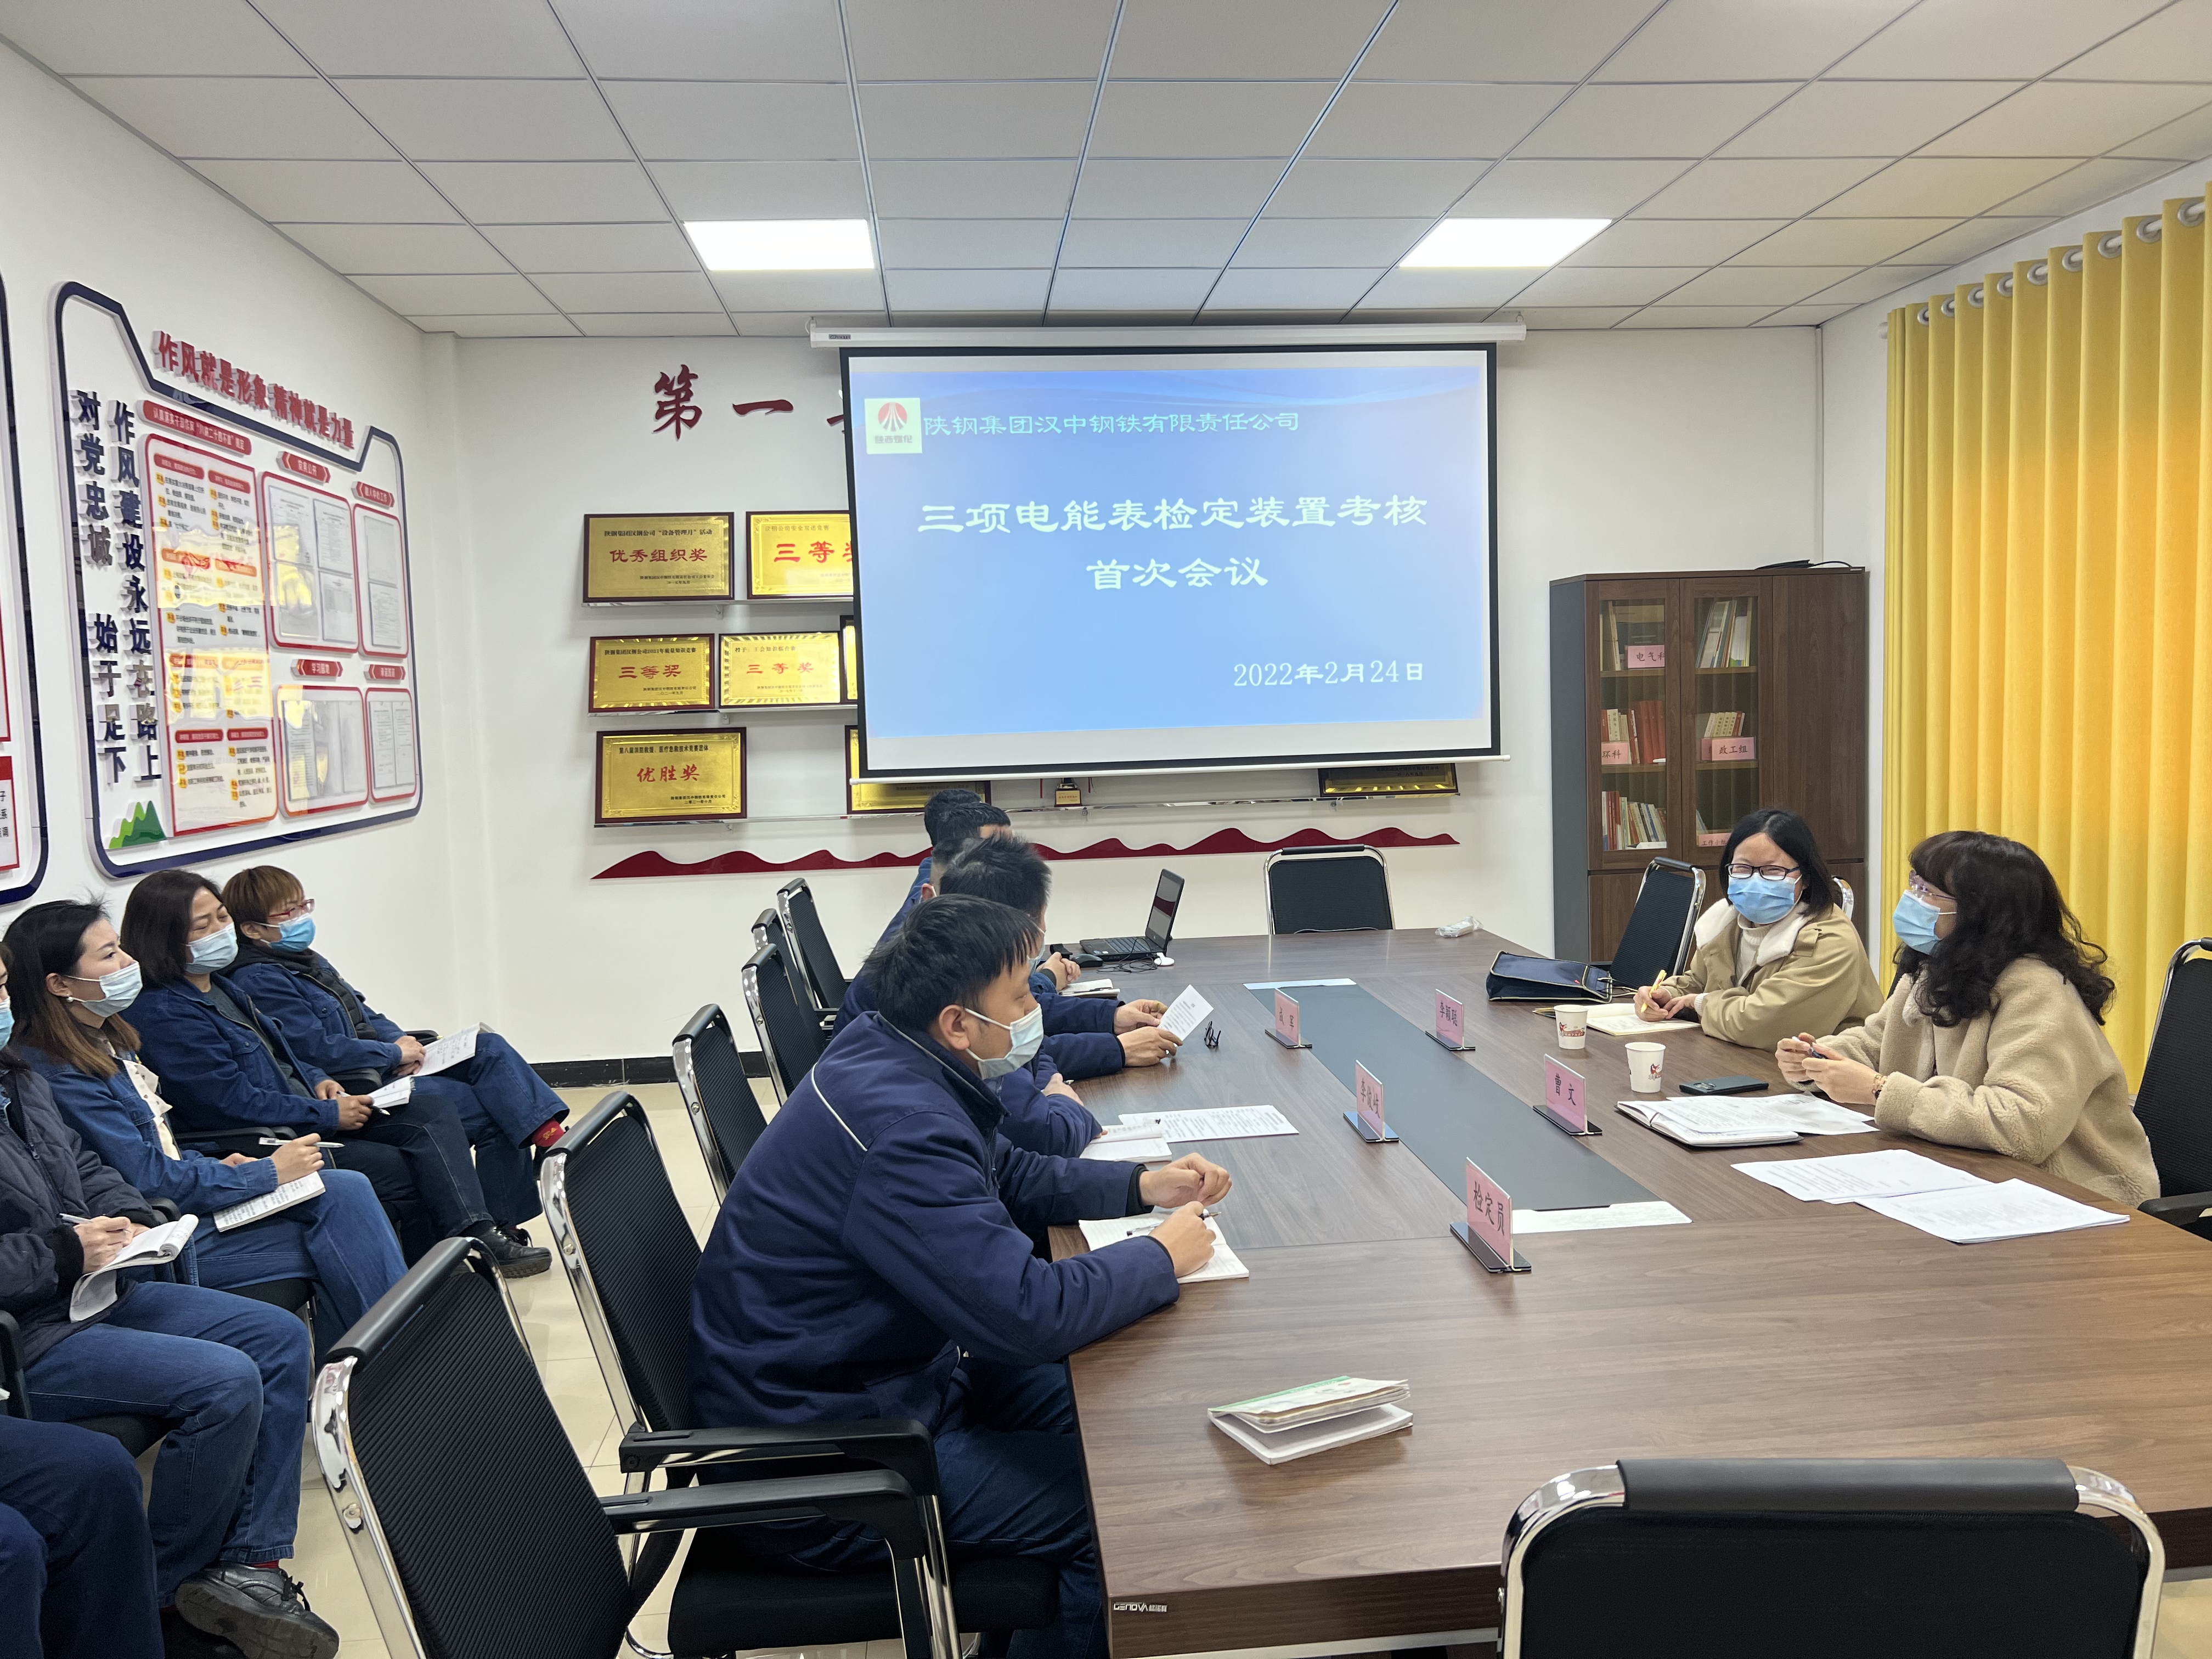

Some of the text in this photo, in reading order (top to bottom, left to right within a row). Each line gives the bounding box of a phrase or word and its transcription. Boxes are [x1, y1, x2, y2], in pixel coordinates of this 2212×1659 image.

[923, 411, 1300, 436] 陕钢集团汉中钢铁有限责任公司
[918, 494, 1427, 533] 三项电能表检定装置考核
[610, 548, 707, 562] 优秀组织奖
[1087, 557, 1268, 590] 首次会议
[114, 400, 161, 781] 作风建设永远在路上
[747, 662, 814, 674] 三等奖
[1636, 652, 1664, 662] 电气科
[619, 664, 681, 679] 三等奖
[1234, 660, 1423, 686] 2022年2月24日
[1719, 744, 1747, 754] 政工组
[637, 764, 700, 782] 优胜奖
[1555, 1073, 1576, 1106] 曹文
[1473, 1180, 1505, 1236] 检定员
